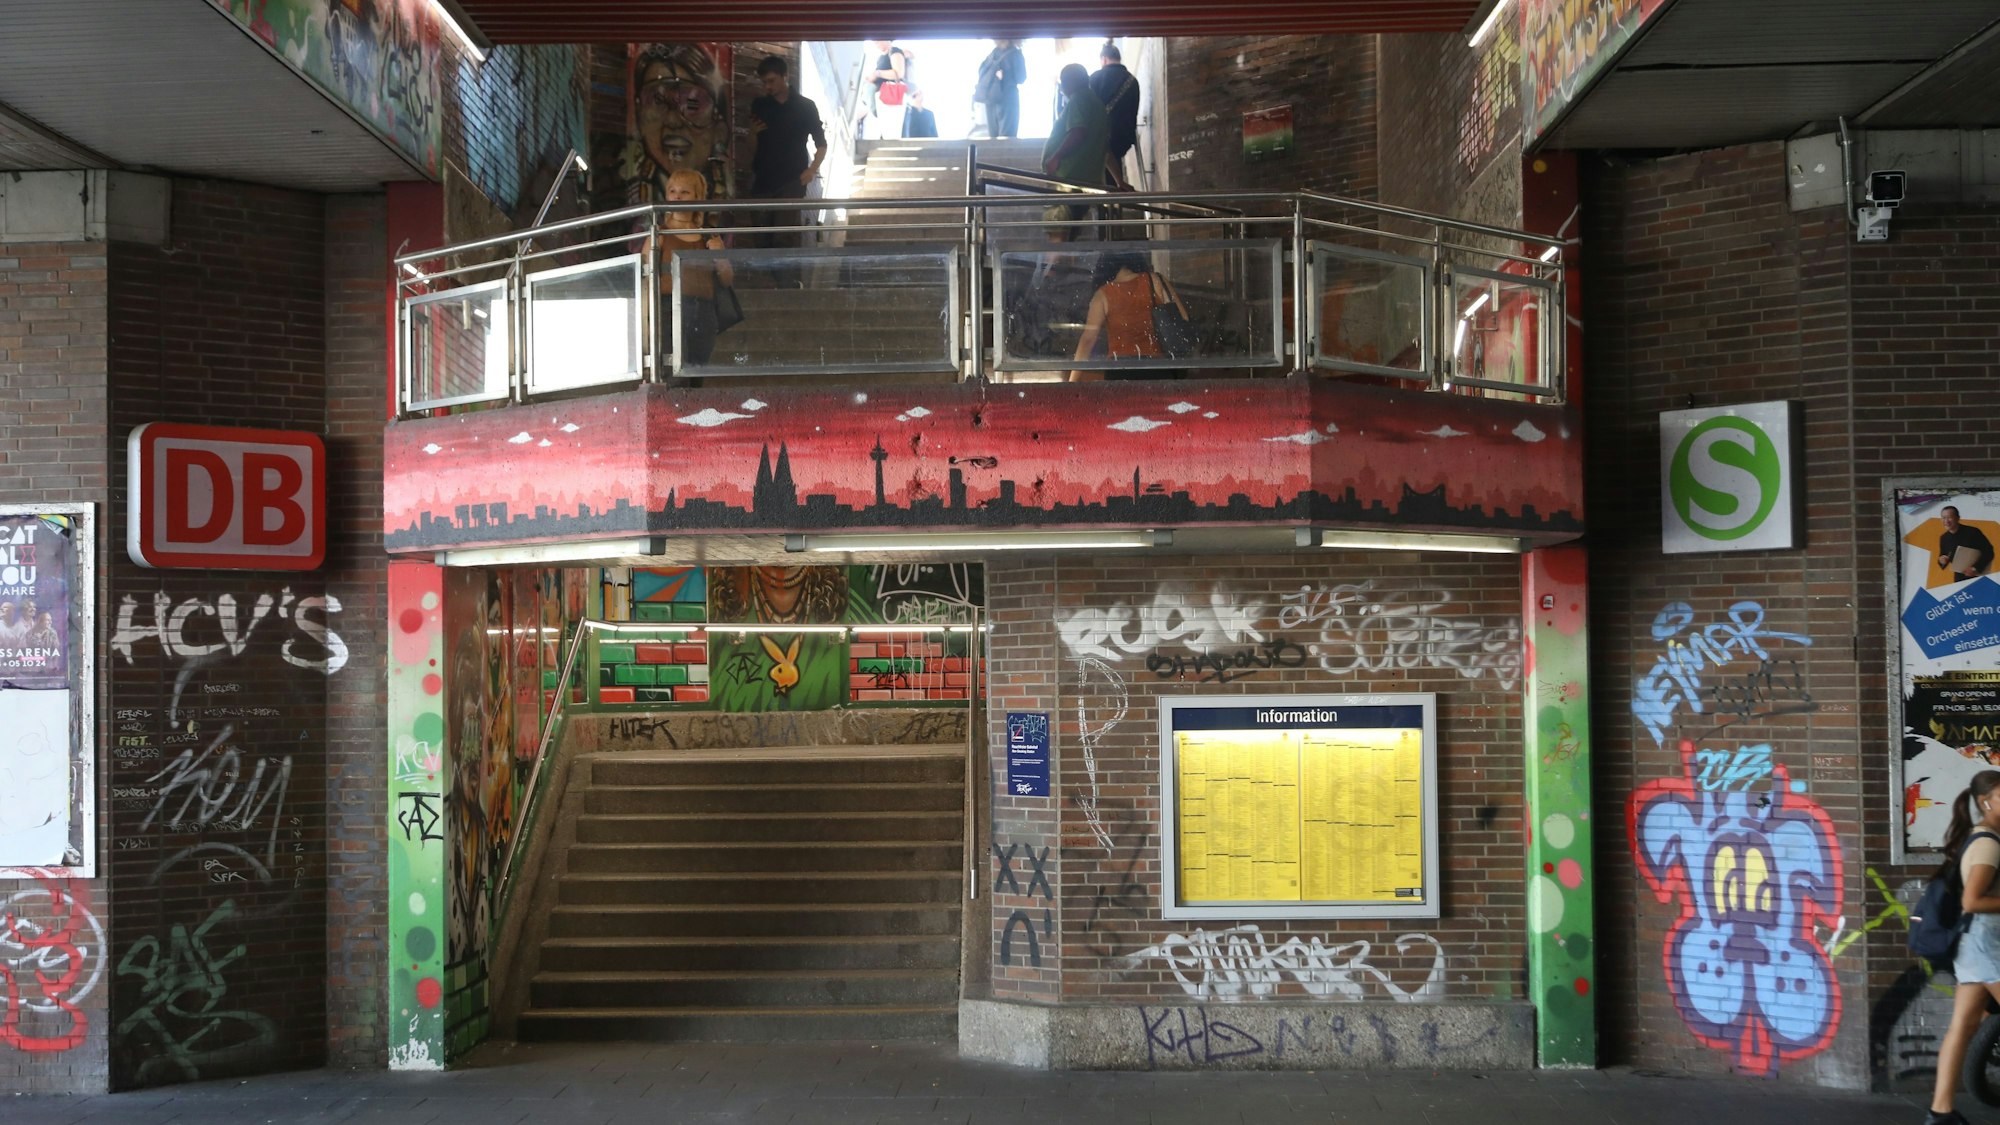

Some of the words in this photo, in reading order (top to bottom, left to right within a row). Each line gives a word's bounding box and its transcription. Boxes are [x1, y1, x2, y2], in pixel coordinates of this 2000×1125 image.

[1688, 427, 1762, 530] S
[166, 448, 306, 546] DB
[1925, 600, 1955, 621] Glück
[1962, 605, 1993, 616] wenn
[1926, 619, 1979, 646] Orchester
[16, 647, 61, 657] ARENA
[1256, 709, 1338, 724] Information
